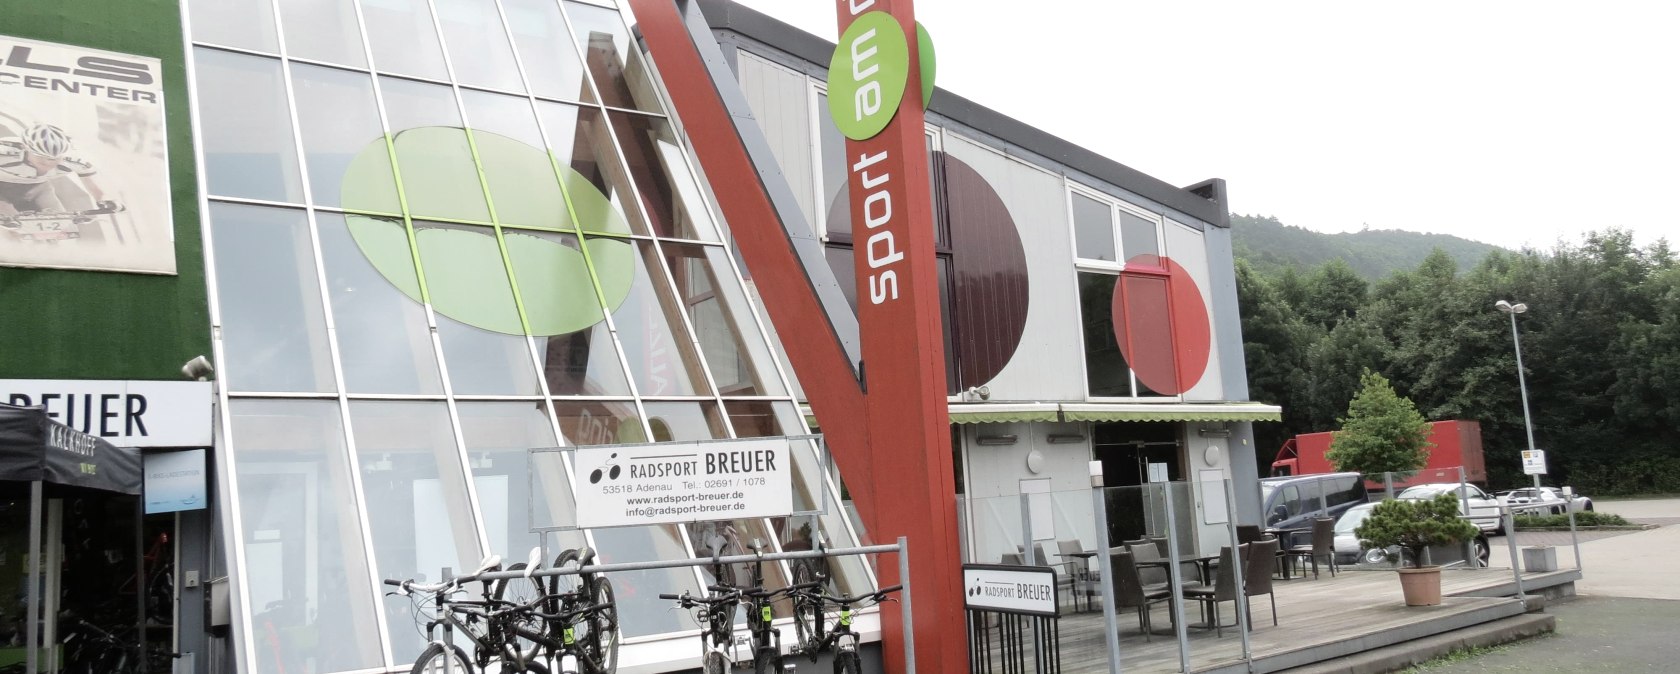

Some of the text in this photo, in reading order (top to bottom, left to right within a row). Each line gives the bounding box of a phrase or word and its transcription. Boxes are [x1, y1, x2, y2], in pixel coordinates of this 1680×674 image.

[0, 45, 154, 85] LS
[851, 28, 881, 122] am
[853, 150, 904, 305] sport
[50, 424, 97, 457] KALKHOFF
[630, 449, 777, 479] RADSPORT BREUER
[602, 484, 633, 495] 53518
[636, 483, 673, 493] Adenau
[704, 479, 733, 489] 02691
[743, 477, 766, 486] 1078
[626, 490, 744, 506] www.radsport-breuer.de
[625, 502, 745, 517] info@radsport-breuer.de
[984, 583, 1052, 601] RADSPORT BREUER
